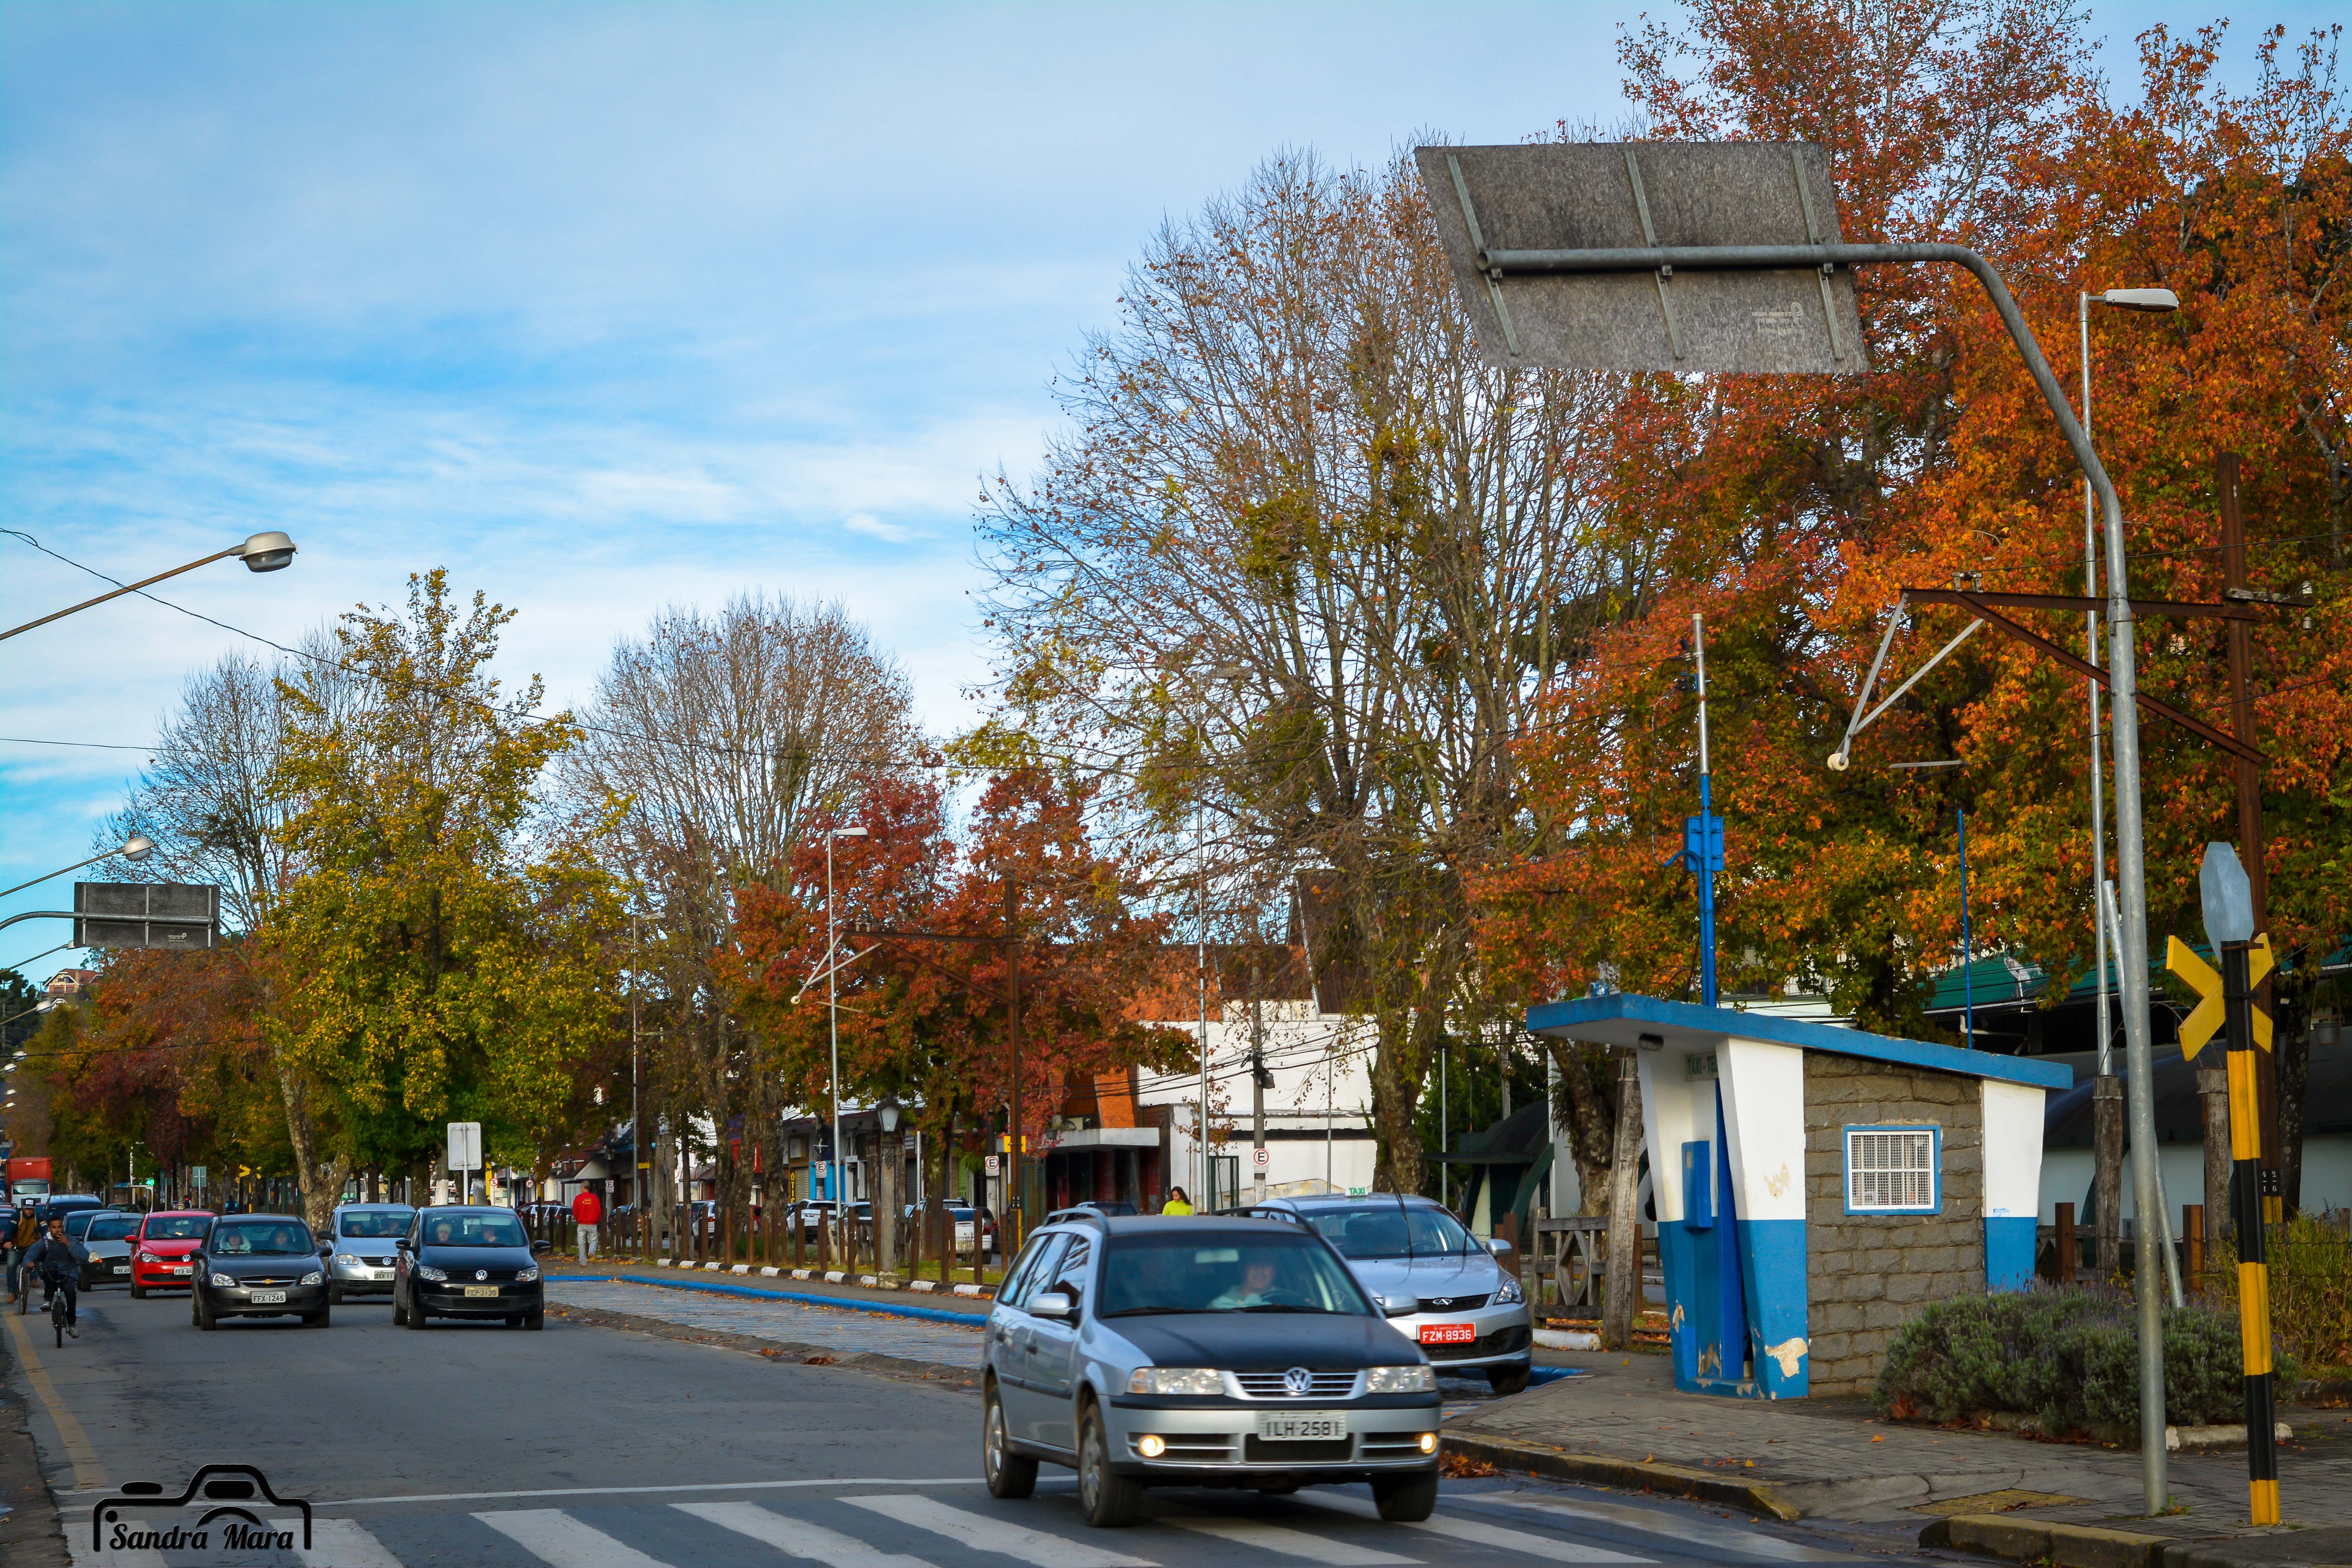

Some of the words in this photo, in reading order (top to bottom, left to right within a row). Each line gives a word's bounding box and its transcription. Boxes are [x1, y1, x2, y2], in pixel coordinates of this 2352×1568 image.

[1687, 1056, 1702, 1075] TAXI
[1258, 1152, 1265, 1162] E
[989, 1159, 996, 1167] E
